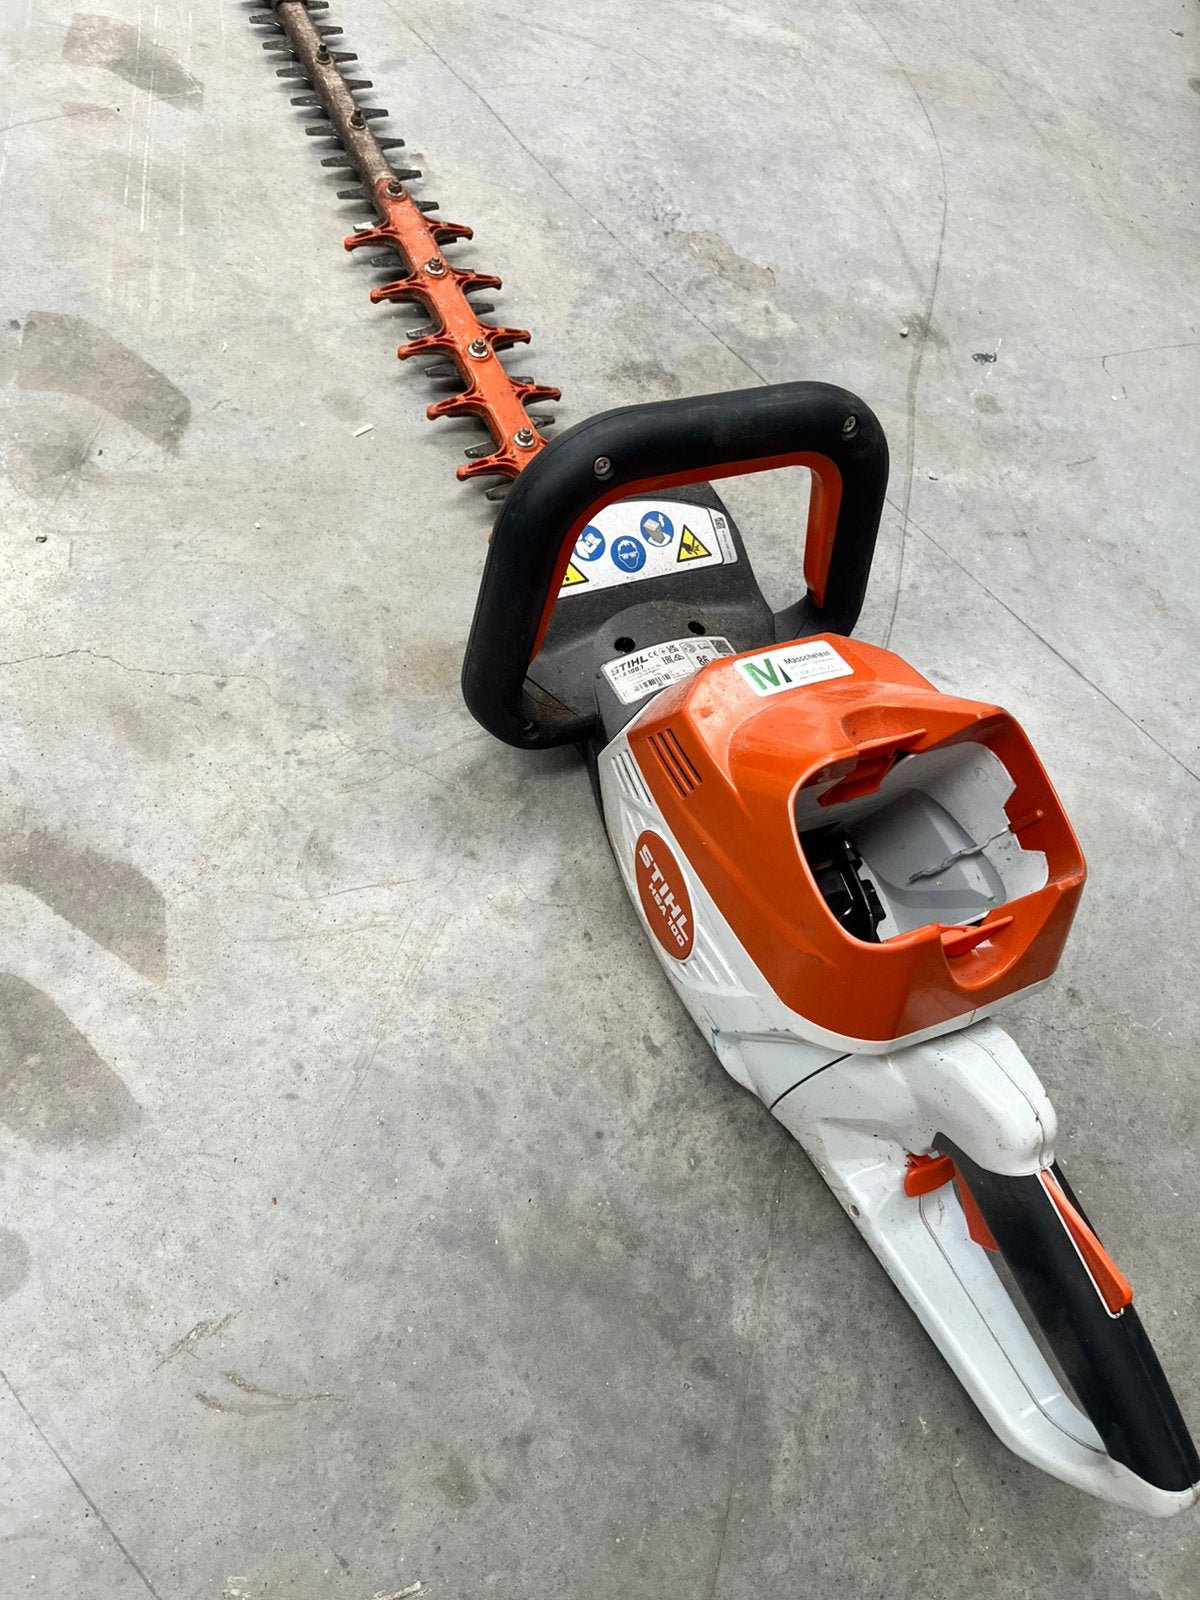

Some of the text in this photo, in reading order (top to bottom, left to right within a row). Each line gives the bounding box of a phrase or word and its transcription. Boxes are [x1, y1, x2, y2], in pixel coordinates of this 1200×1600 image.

[611, 656, 649, 676] STIHL
[639, 844, 689, 942] STIHL
[648, 882, 685, 947] HSA 100
